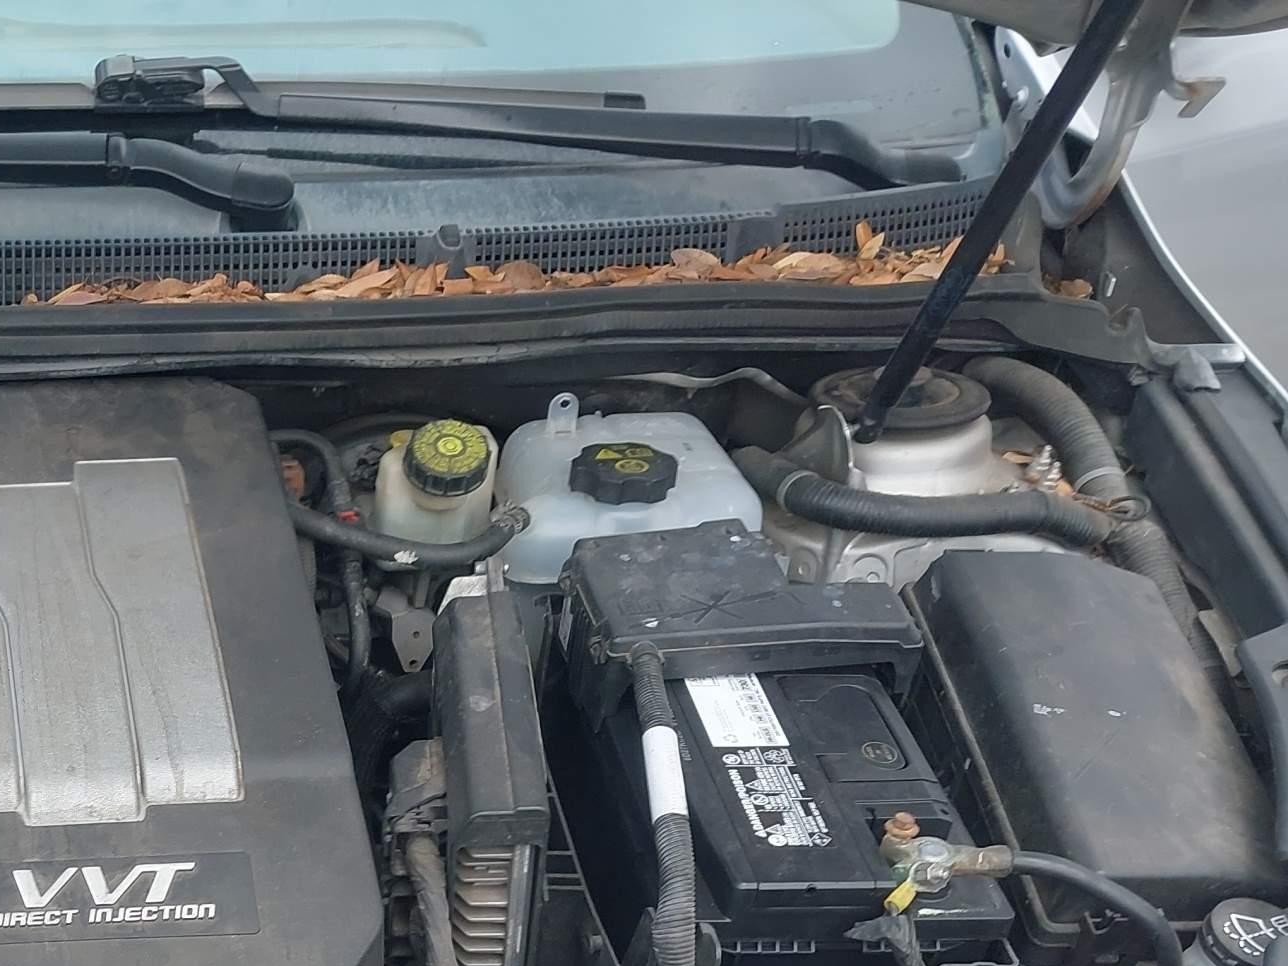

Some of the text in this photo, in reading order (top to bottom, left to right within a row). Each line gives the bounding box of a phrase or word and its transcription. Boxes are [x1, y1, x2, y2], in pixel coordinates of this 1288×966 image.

[728, 769, 764, 831] DANGER/POISON
[12, 862, 196, 908] VVT
[88, 903, 216, 923] INJECTION
